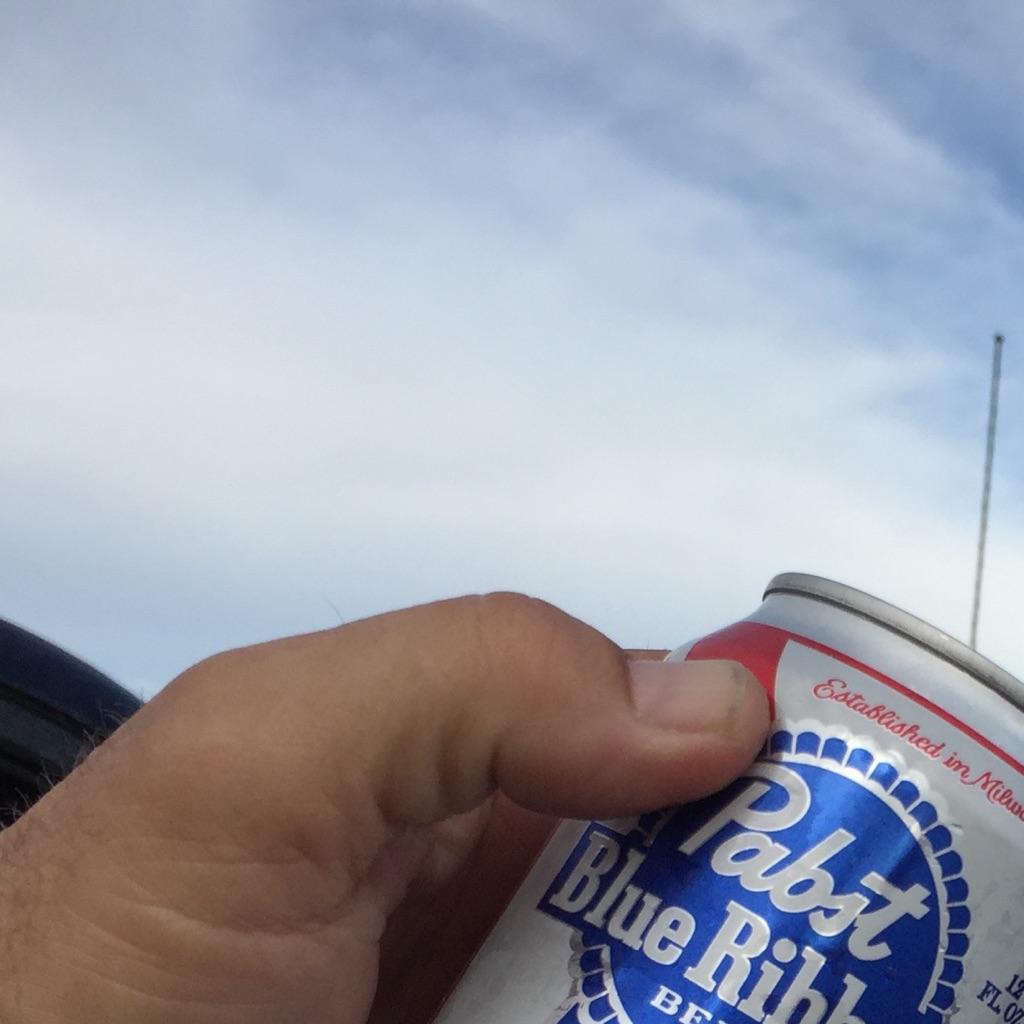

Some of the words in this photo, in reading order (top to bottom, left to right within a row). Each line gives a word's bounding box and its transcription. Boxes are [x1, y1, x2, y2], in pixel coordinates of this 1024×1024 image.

[812, 678, 941, 761] Established
[943, 752, 972, 780] in
[549, 830, 696, 965] Blue
[678, 761, 930, 962] Pabst
